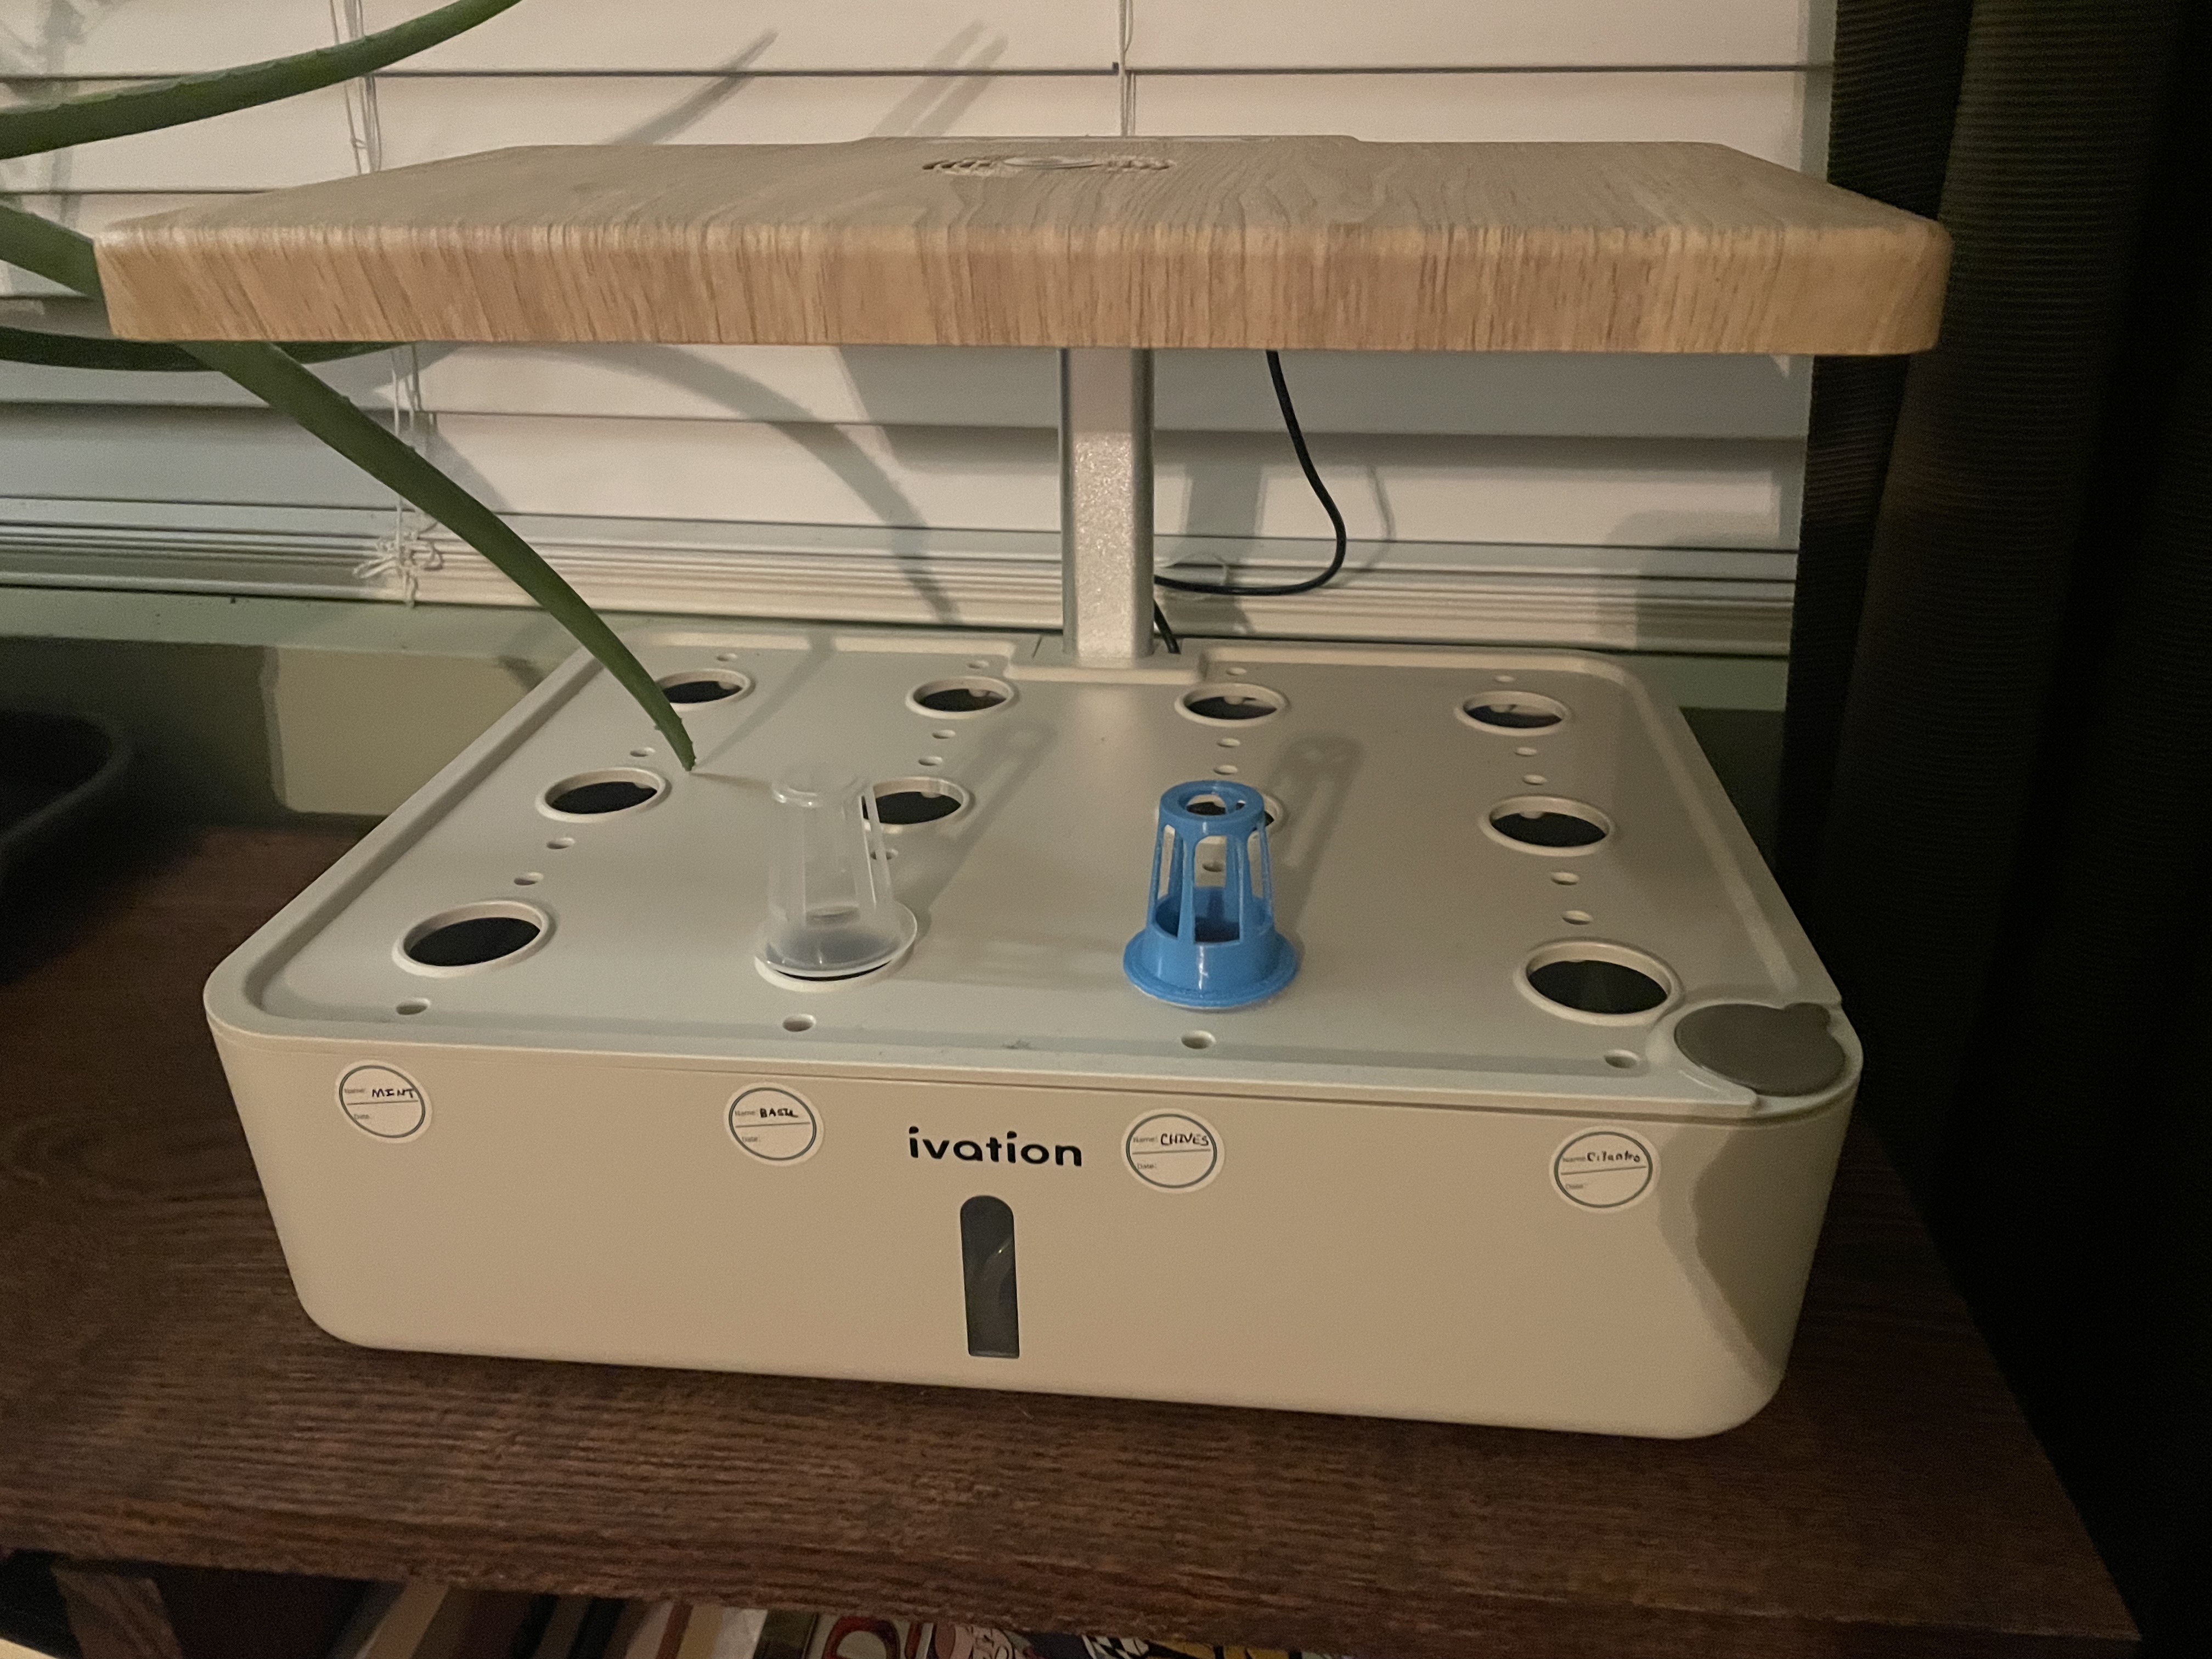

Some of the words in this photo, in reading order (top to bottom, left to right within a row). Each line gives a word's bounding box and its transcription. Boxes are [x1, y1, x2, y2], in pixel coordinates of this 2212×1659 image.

[371, 1088, 415, 1098] MINT
[1160, 1132, 1209, 1146] CHIVES
[909, 1126, 1082, 1167] ivation
